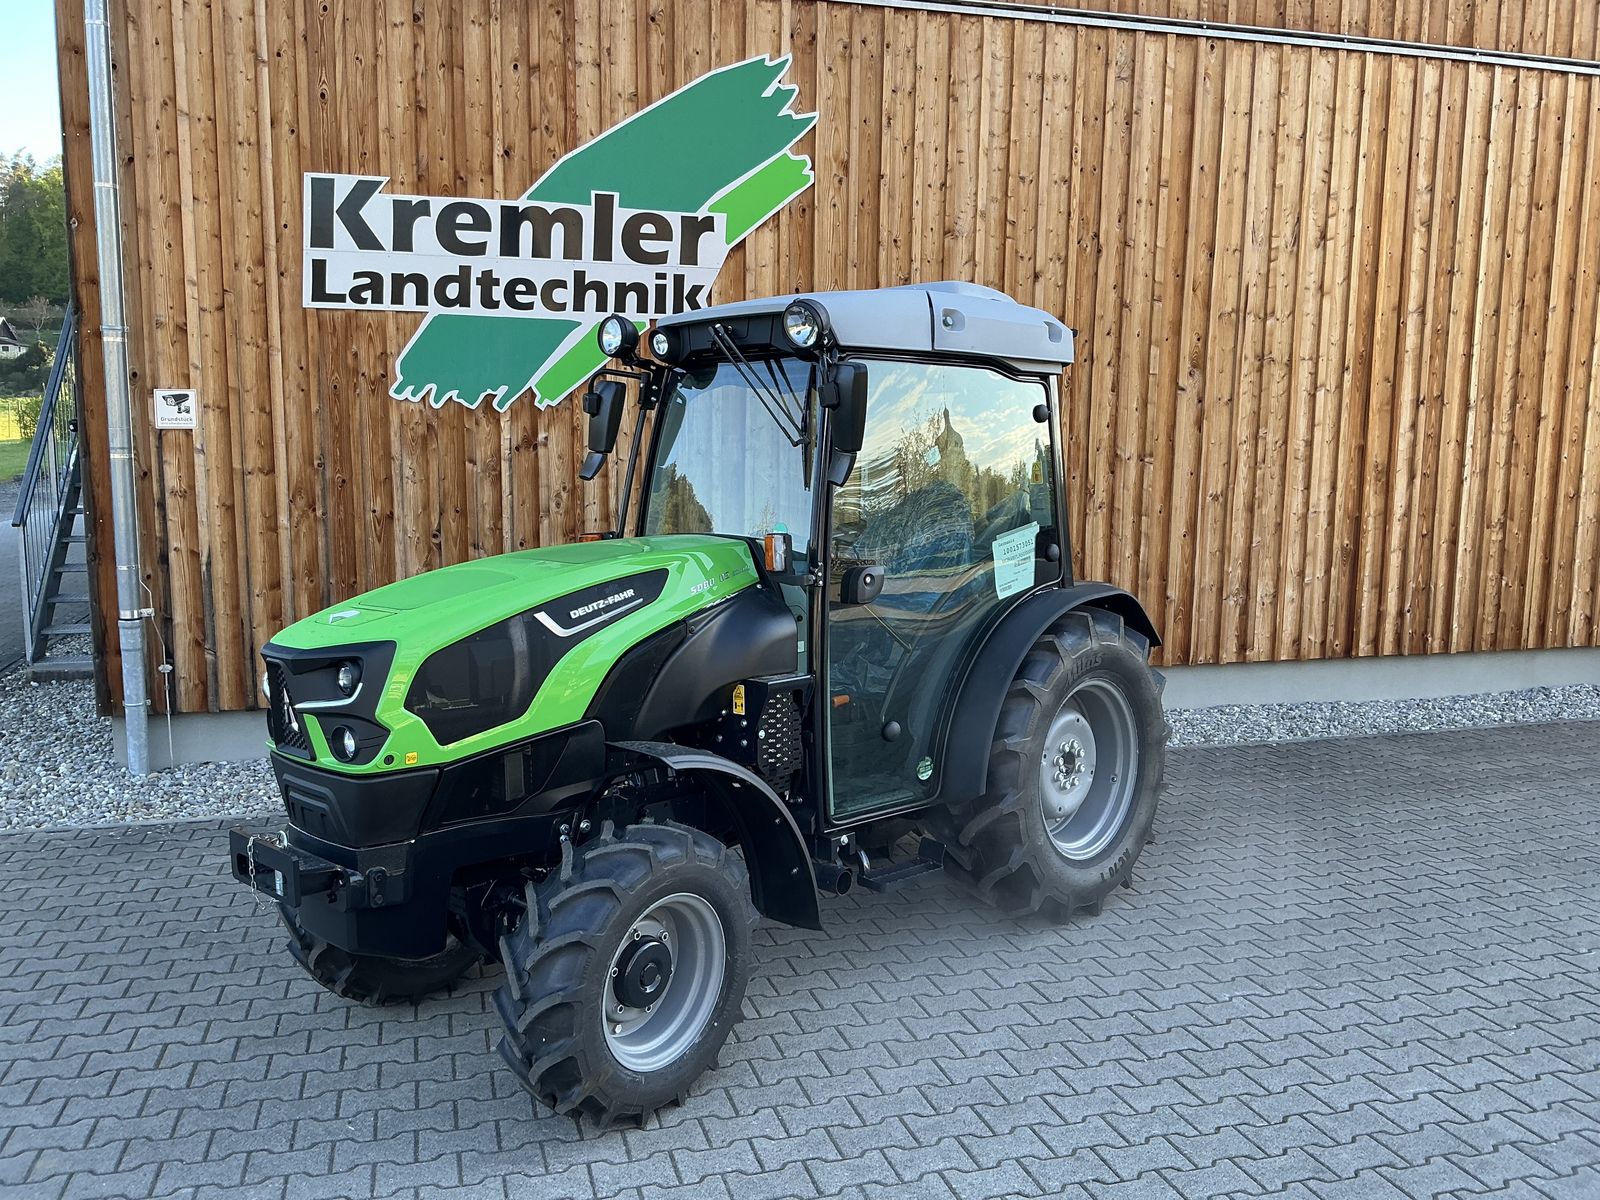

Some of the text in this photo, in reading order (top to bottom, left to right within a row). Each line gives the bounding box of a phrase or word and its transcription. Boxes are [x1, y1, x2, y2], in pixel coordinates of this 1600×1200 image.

[310, 177, 715, 266] Kremler
[311, 258, 707, 315] Landtechnik
[569, 588, 636, 619] DEUTZ-FAHR
